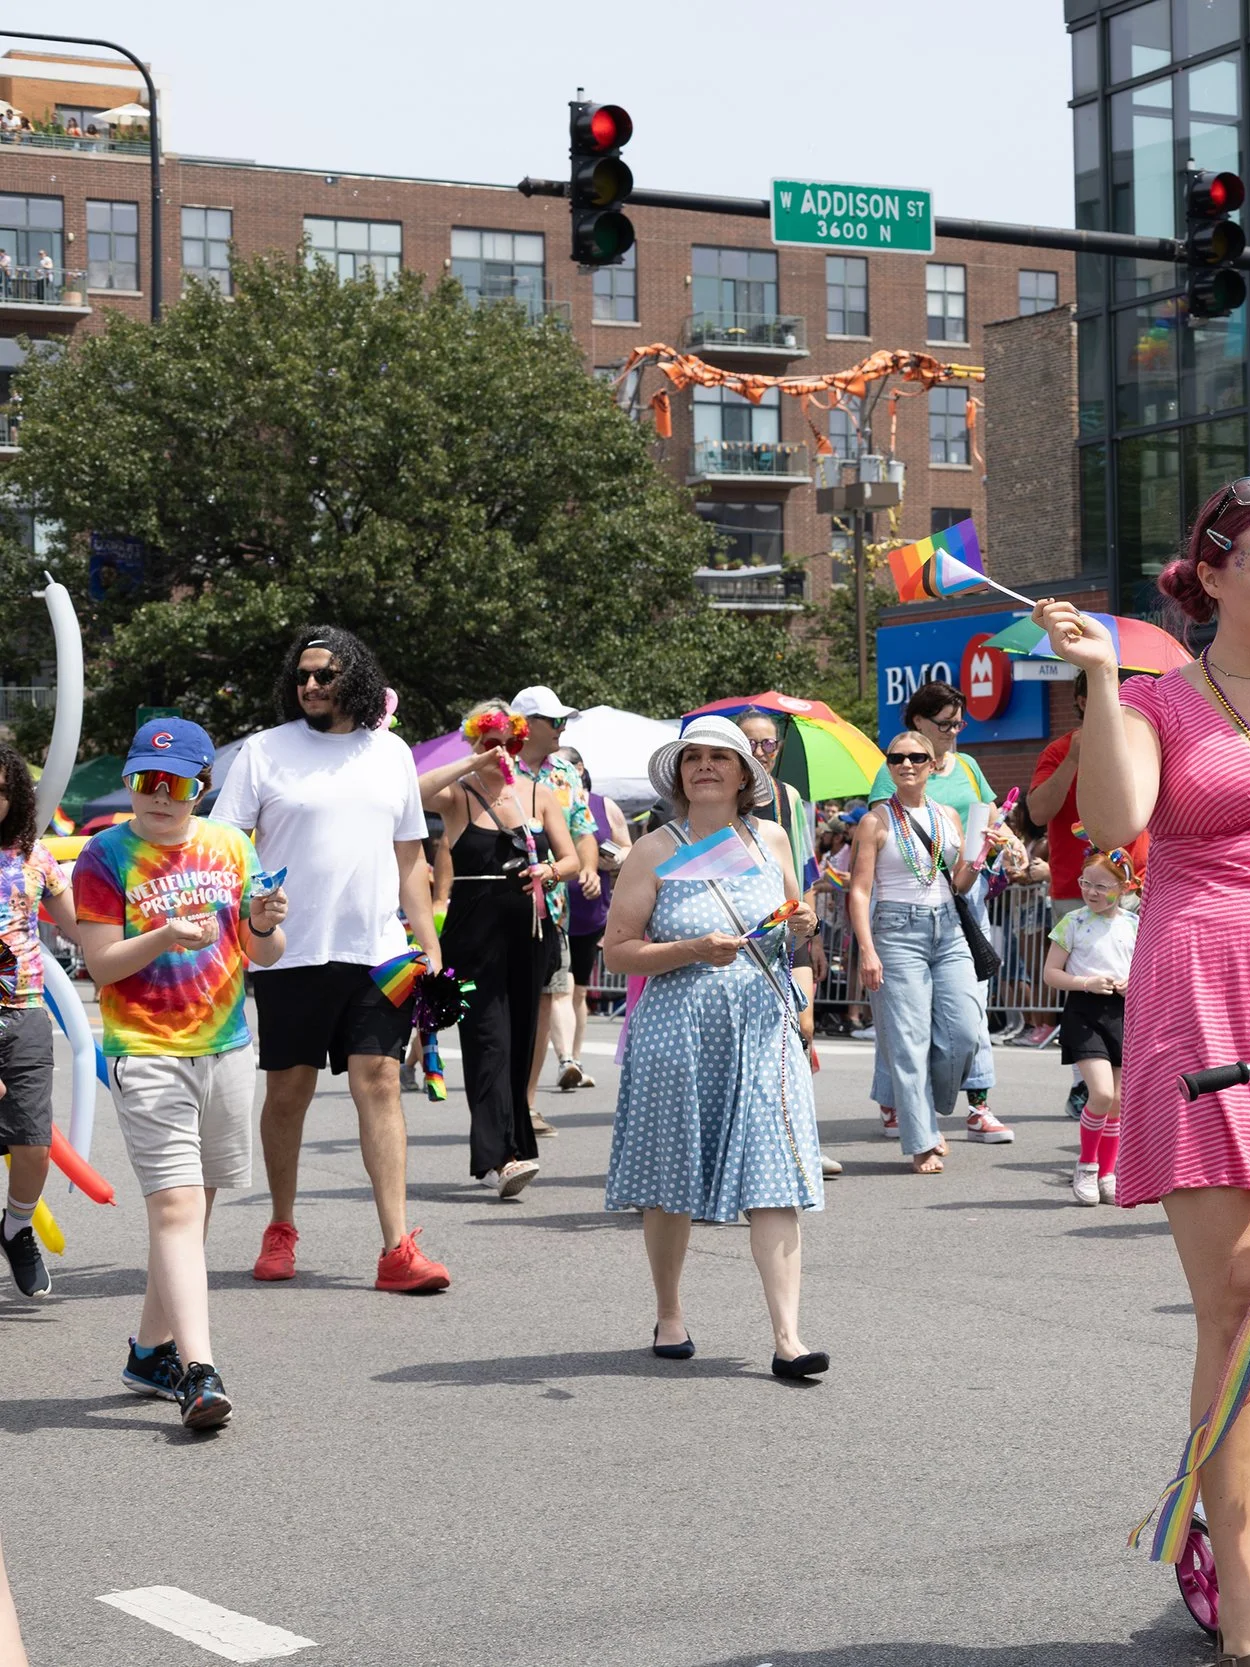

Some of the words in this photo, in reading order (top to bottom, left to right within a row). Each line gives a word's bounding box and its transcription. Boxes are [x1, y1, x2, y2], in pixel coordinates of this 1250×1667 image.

[780, 191, 792, 209] W
[800, 189, 899, 221] ADDISON
[907, 201, 925, 217] ST
[817, 220, 868, 239] 3600
[880, 225, 891, 242] N
[884, 661, 952, 705] BMO
[1039, 665, 1058, 676] ATM
[151, 732, 173, 749] C
[126, 871, 241, 904] NETTELHORST
[140, 887, 238, 918] PRESCHOOL
